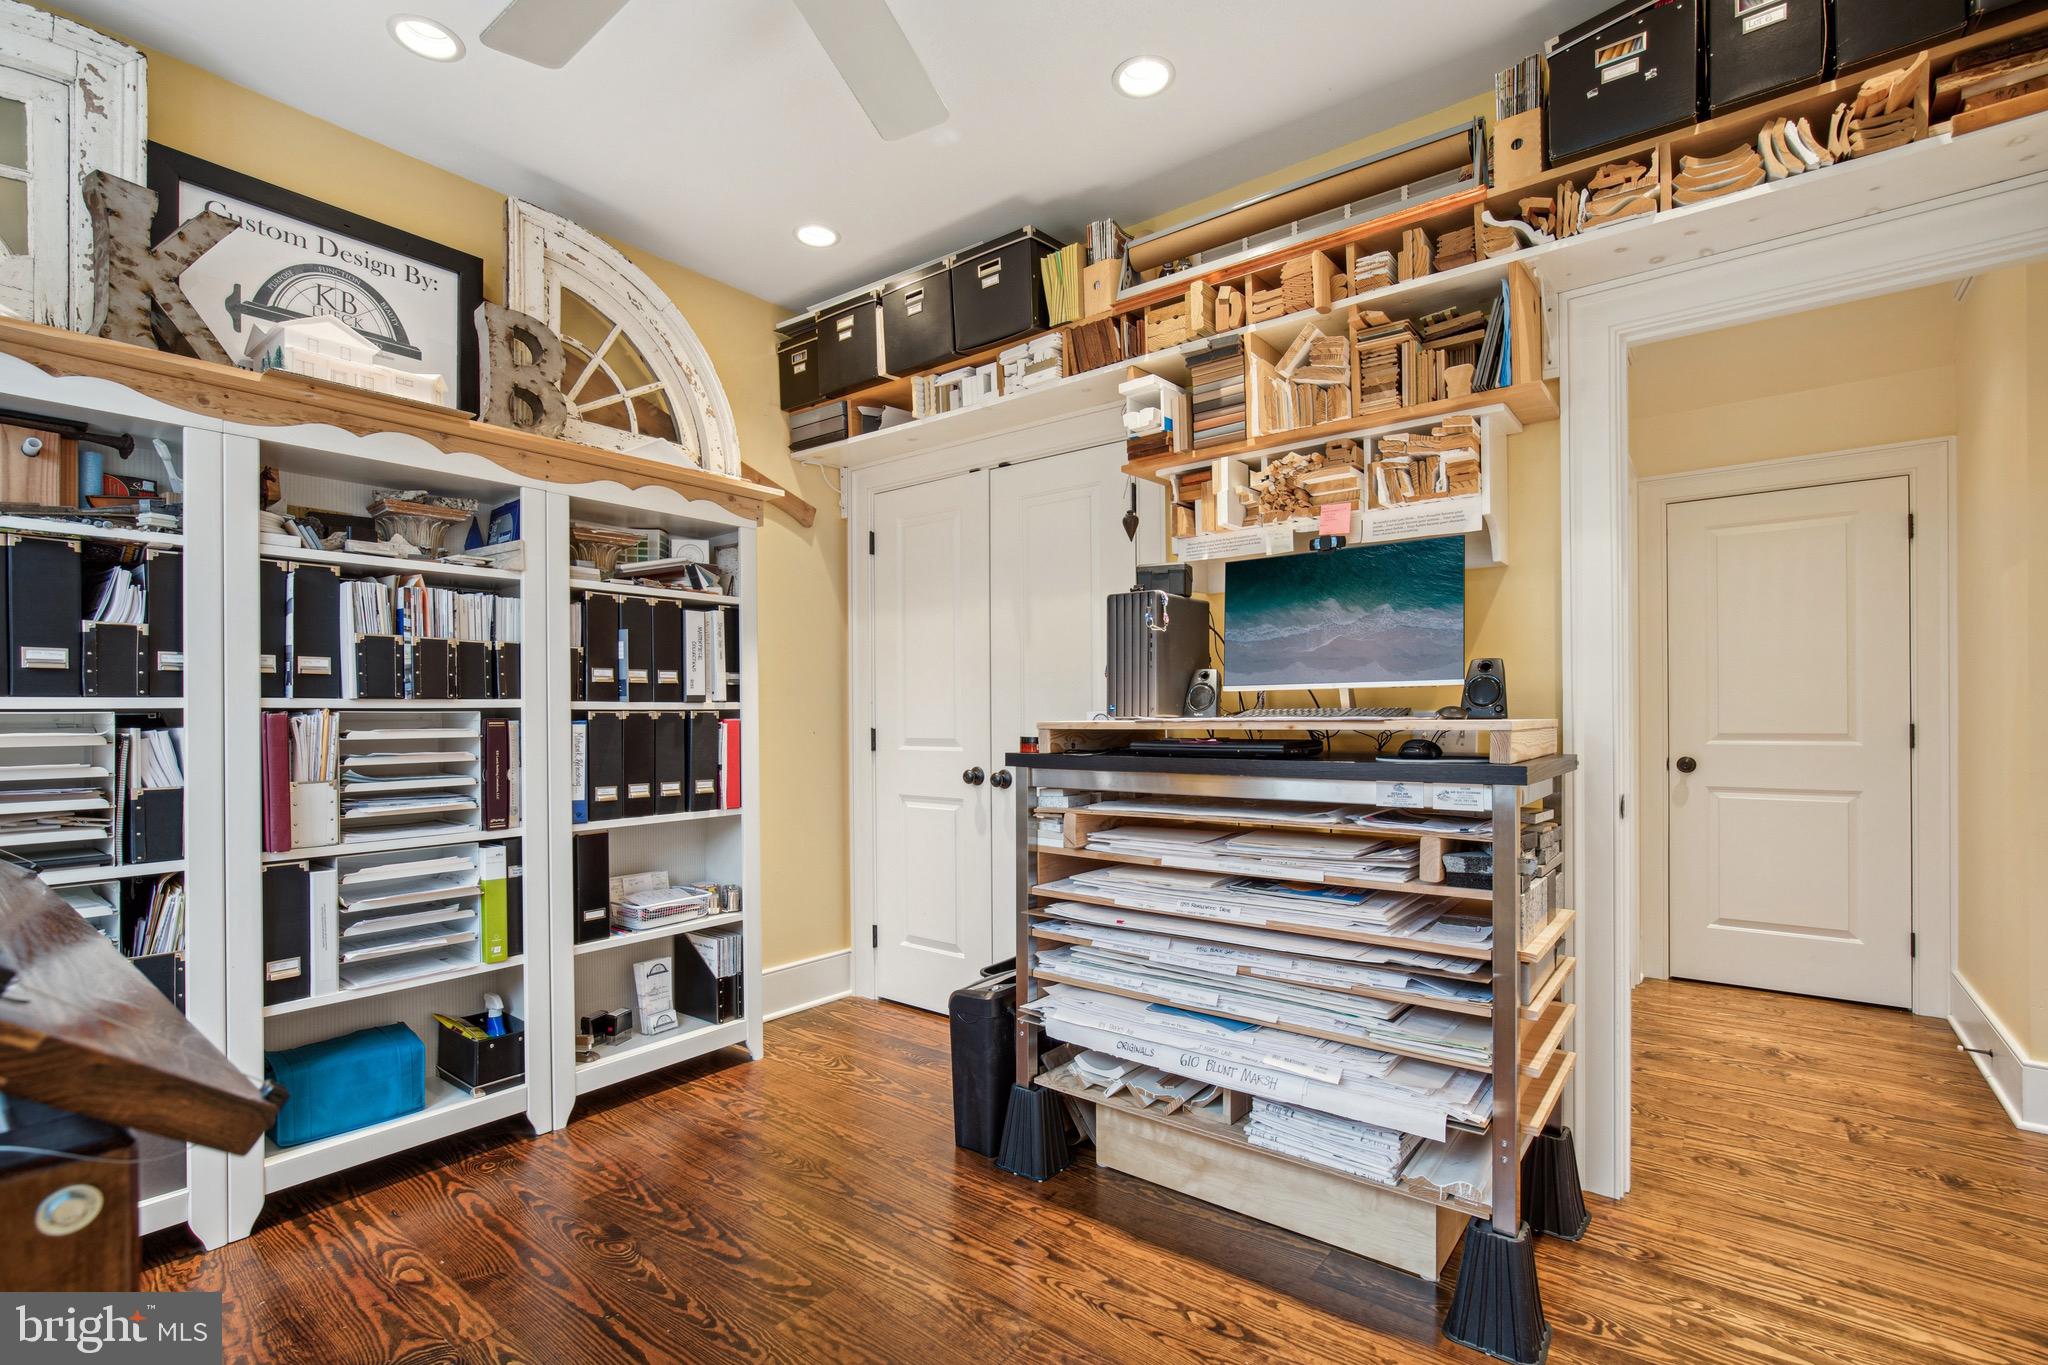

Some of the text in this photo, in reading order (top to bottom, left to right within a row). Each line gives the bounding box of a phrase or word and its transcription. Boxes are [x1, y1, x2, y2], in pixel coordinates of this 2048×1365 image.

[317, 235, 396, 278] Design
[404, 264, 439, 292] By:
[318, 265, 362, 286] FUNCTION
[267, 268, 295, 291] PURPOSE
[316, 283, 358, 315] KB
[380, 300, 400, 328] BEAUTY
[1116, 1040, 1155, 1057] ORIGINALS
[1205, 1059, 1238, 1079] BLUNT
[1240, 1068, 1278, 1090] MARSH
